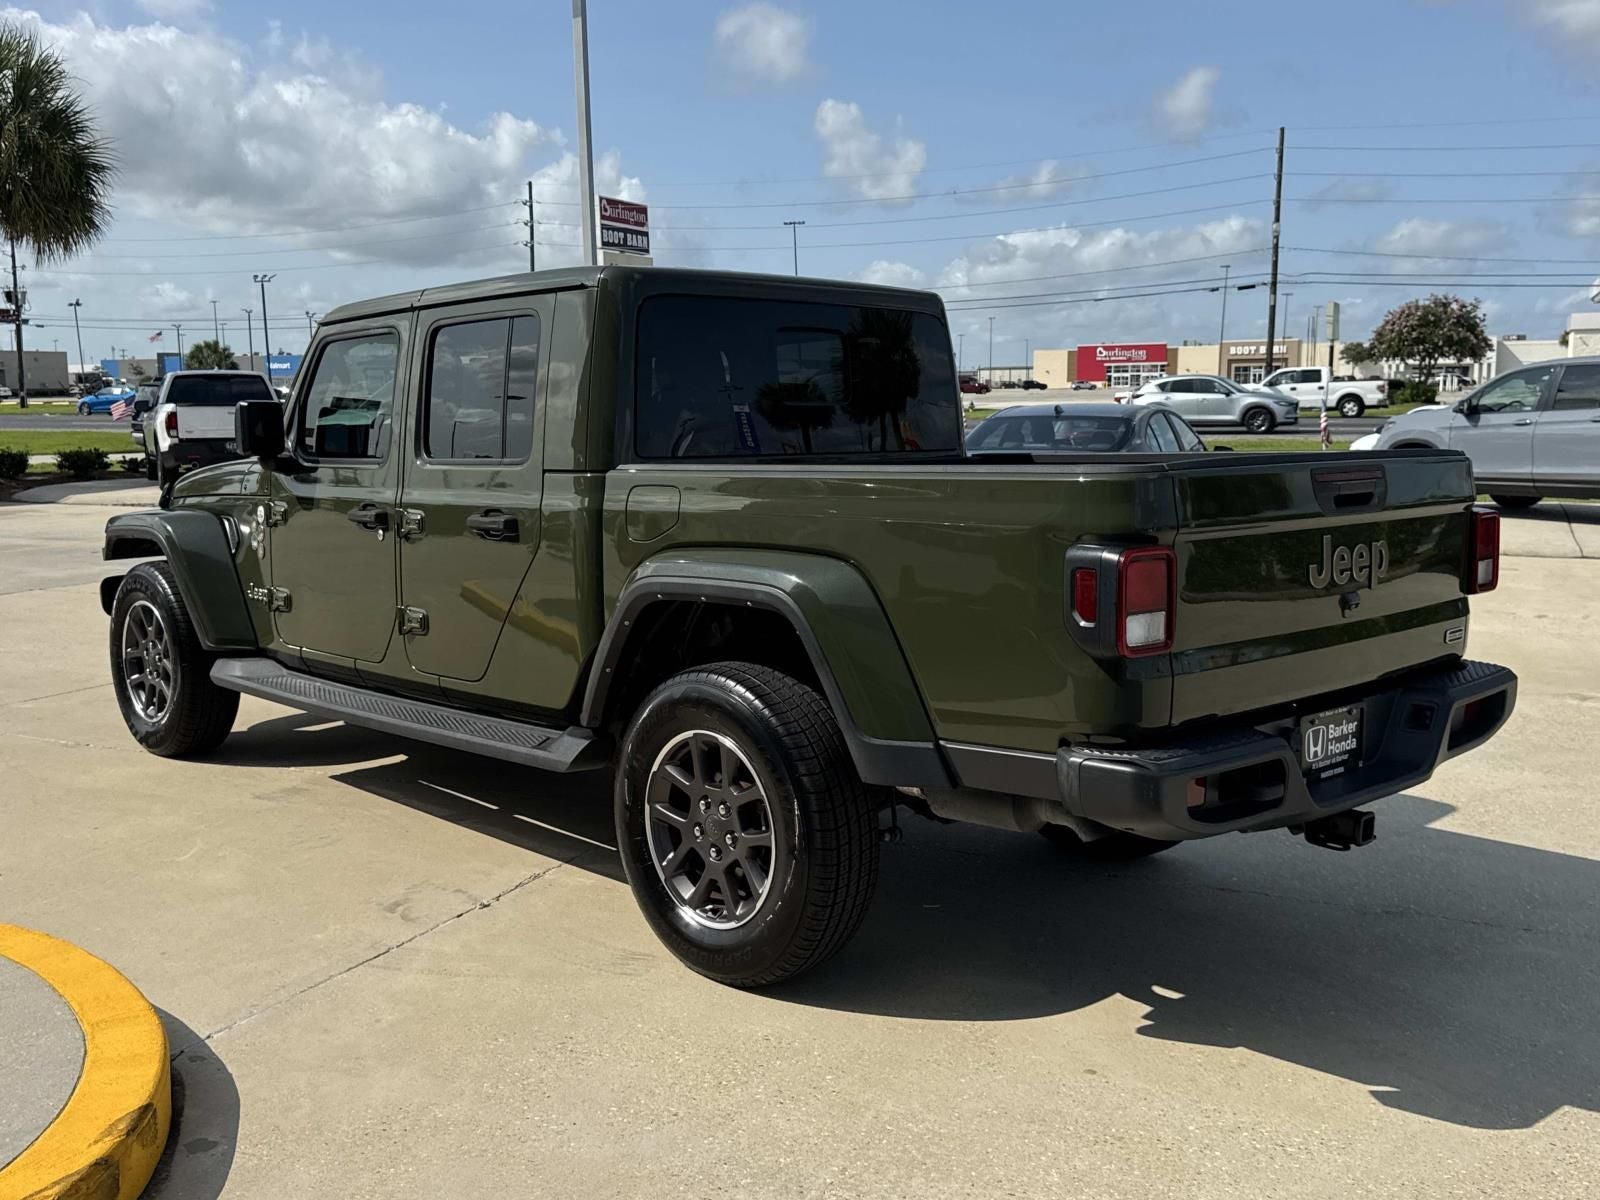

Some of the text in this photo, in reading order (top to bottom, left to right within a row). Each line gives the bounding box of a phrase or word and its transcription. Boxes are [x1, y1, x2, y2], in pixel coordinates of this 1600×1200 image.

[601, 199, 646, 225] Burlington
[602, 229, 648, 249] BOOT BARN
[1096, 347, 1147, 360] Burlington
[1229, 344, 1287, 355] BOOT BRN
[1309, 534, 1389, 590] Jeep
[247, 582, 269, 606] Jeep
[1328, 719, 1358, 739] Barker
[1327, 734, 1357, 756] Honda
